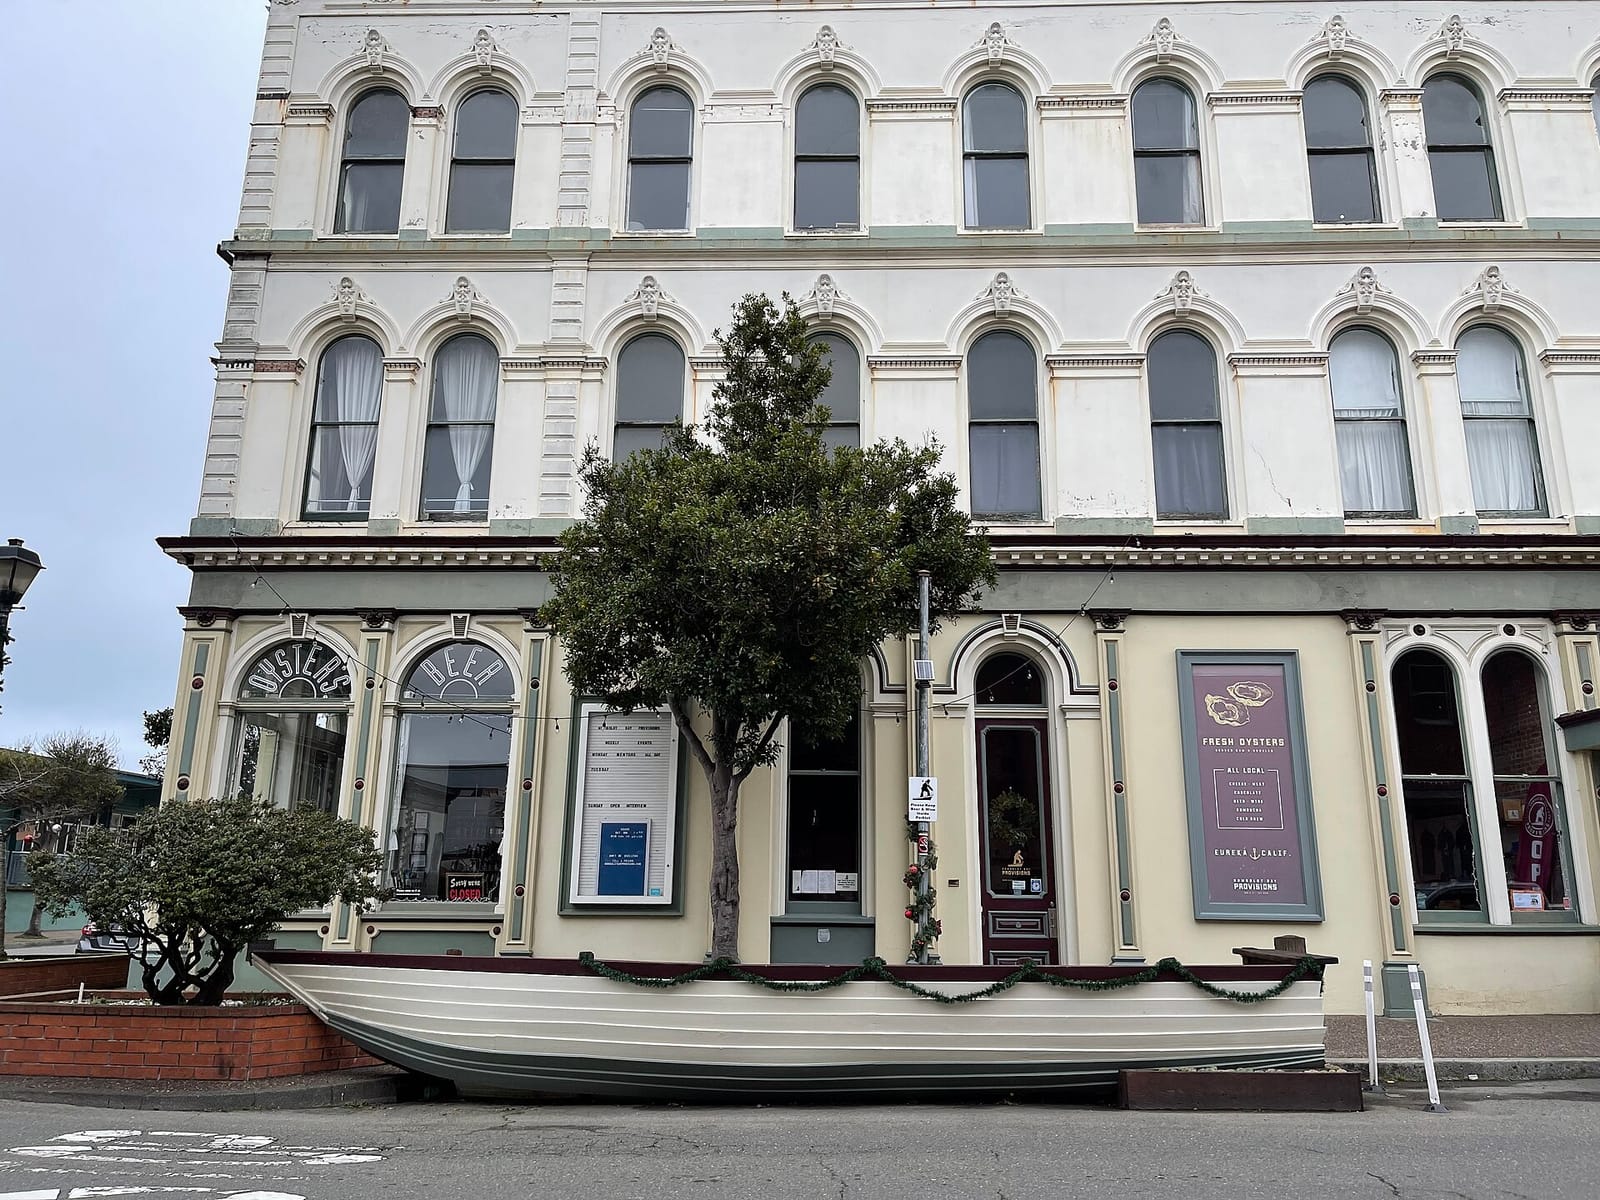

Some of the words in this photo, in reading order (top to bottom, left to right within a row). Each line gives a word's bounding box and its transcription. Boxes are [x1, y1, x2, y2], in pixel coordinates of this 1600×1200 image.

[248, 643, 350, 692] OYSTERS
[420, 646, 504, 687] BEER
[1202, 737, 1234, 746] FRESH
[1239, 738, 1285, 746] OYSTERS
[1214, 848, 1248, 856] EUREKA
[1261, 849, 1292, 857] CALIF.
[1233, 882, 1278, 891] PROVISIONS
[449, 888, 481, 900] CLOSED
